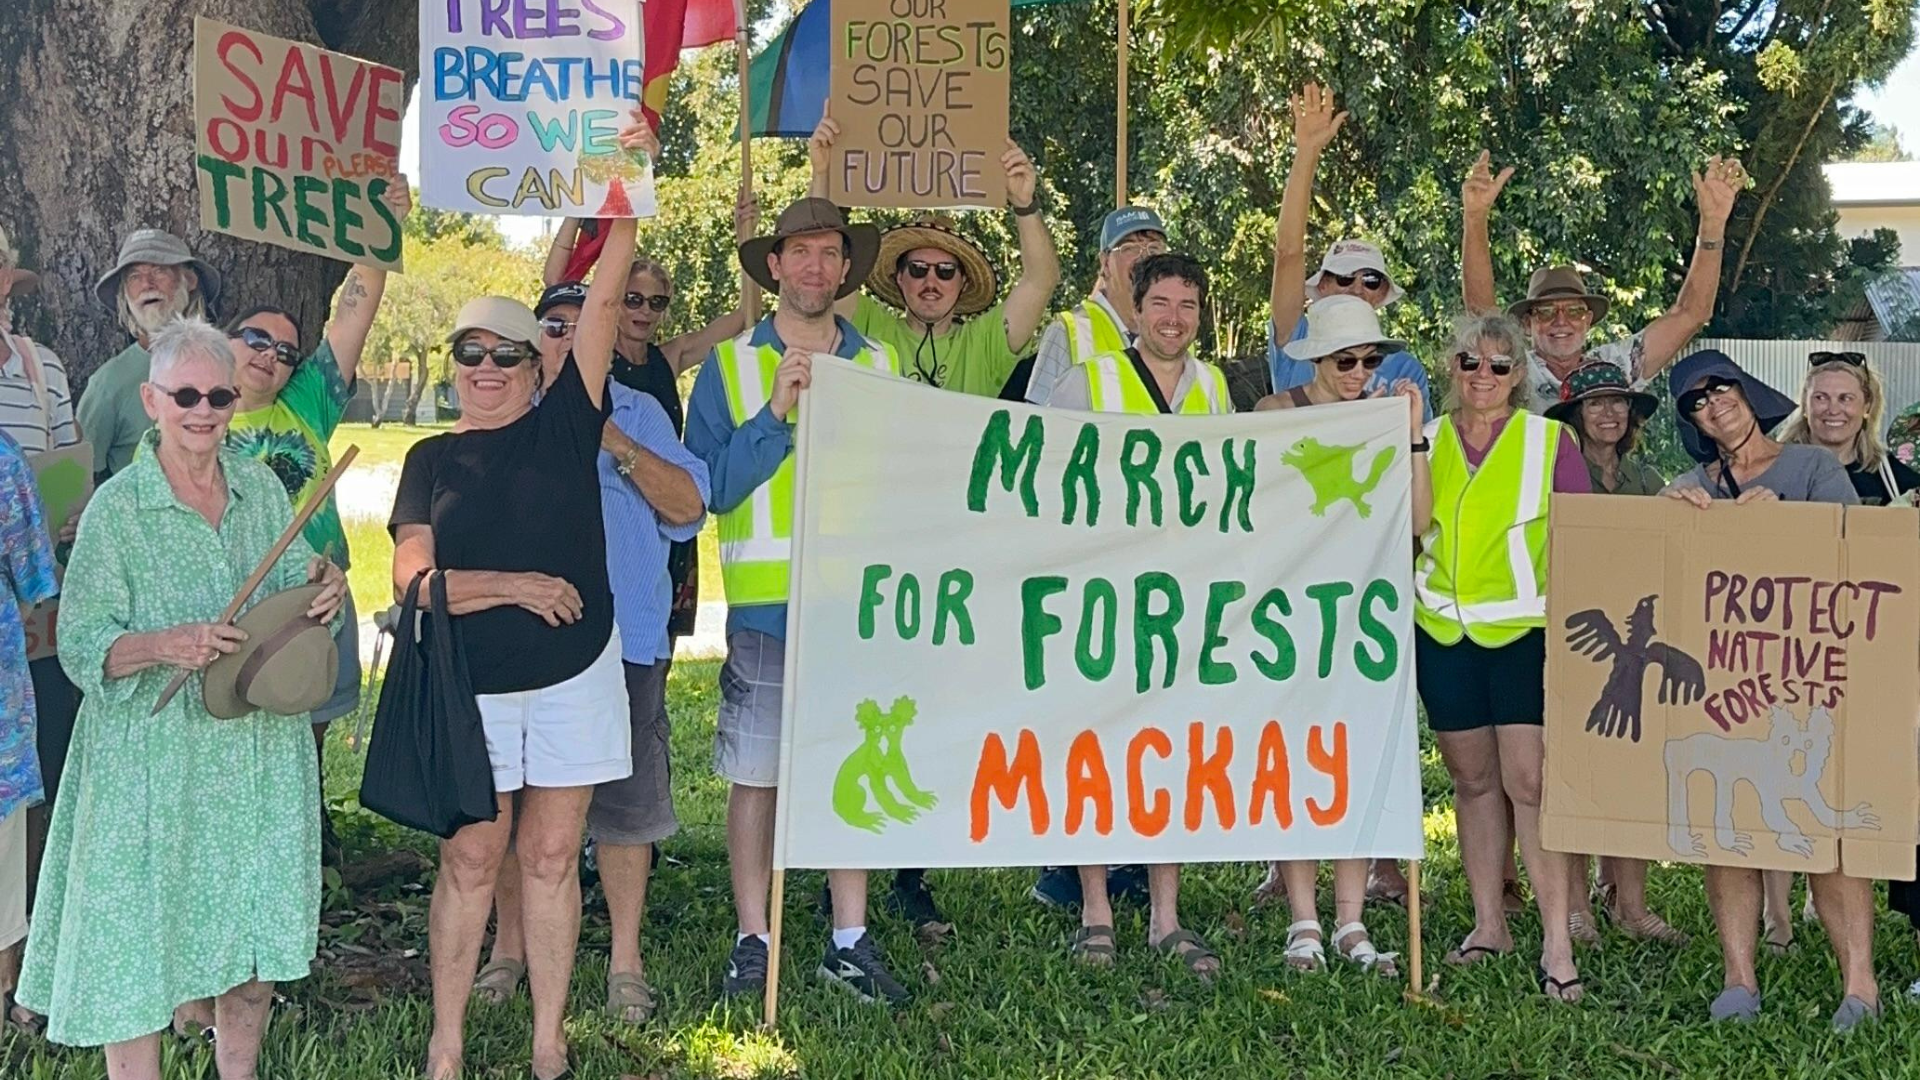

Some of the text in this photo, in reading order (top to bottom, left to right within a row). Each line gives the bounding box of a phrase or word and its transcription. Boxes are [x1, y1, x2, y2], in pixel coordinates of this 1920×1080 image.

[447, 0, 626, 41] TREES
[890, 0, 945, 19] OUR
[846, 20, 1006, 70] FORESTS
[217, 31, 400, 157] SAVE
[434, 46, 644, 101] BREATHE
[847, 64, 973, 109] SAVE
[439, 105, 619, 155] SO WE
[878, 113, 956, 148] OUR
[323, 153, 398, 179] PLEASE
[467, 167, 583, 208] CAN
[844, 149, 987, 199] FUTURE
[198, 155, 401, 262] TREES
[967, 409, 1256, 533] MARCH
[858, 564, 1398, 694] FOR FORESTS
[1705, 570, 1902, 641] PROTECT
[1708, 628, 1848, 682] NATIVE
[1704, 673, 1845, 732] FORESTS
[970, 720, 1347, 843] MACKAY
